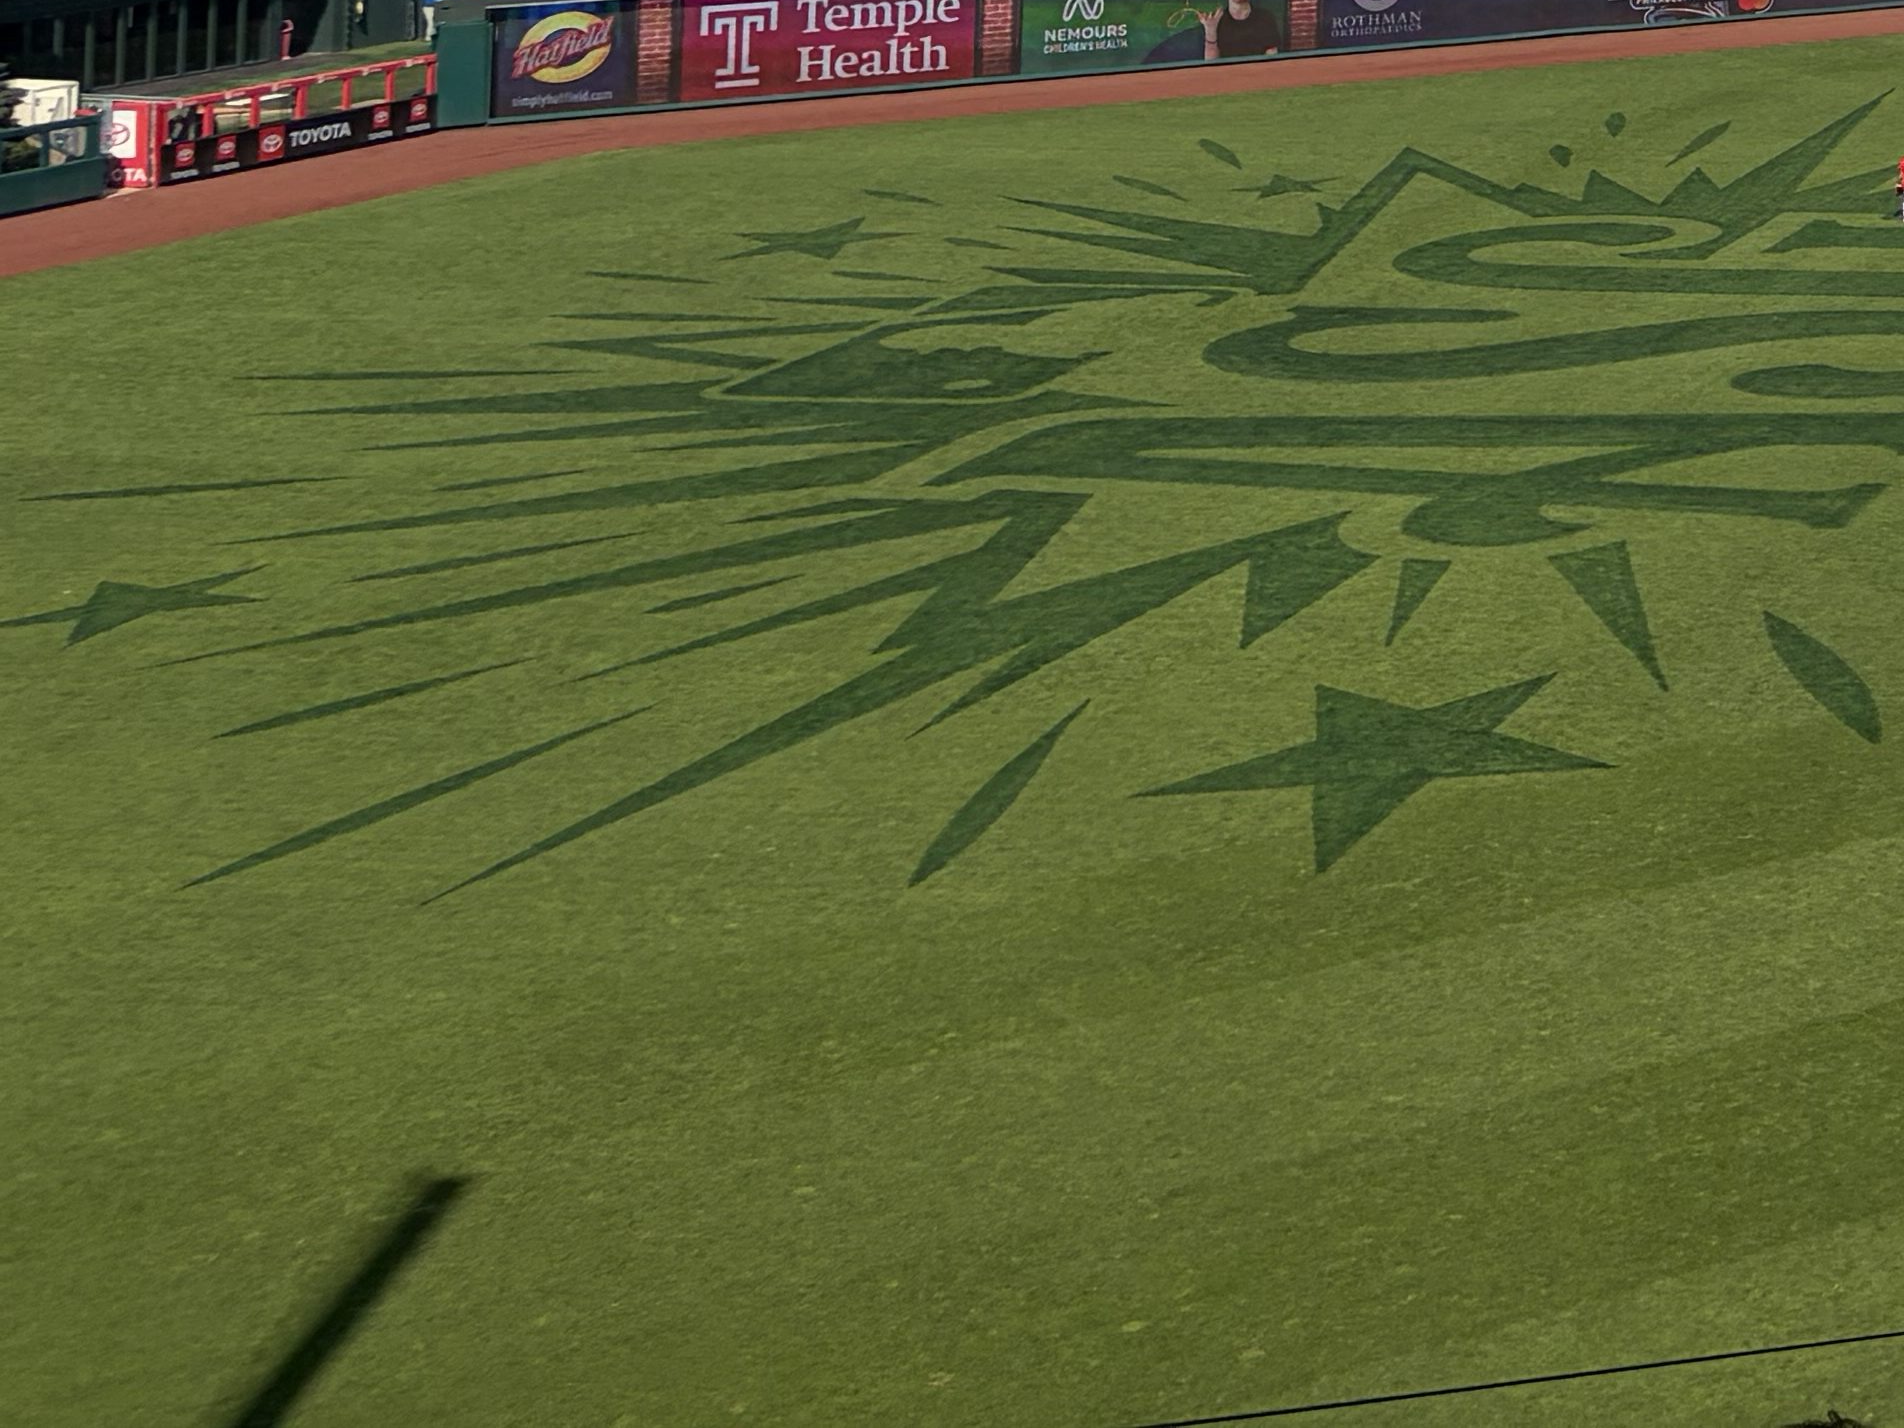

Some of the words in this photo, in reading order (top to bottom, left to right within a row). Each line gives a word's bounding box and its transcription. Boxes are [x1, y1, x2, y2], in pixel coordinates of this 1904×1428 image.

[1331, 10, 1423, 29] ROTHMAN
[1044, 24, 1128, 43] NEMOURS
[511, 15, 615, 79] Hatfield
[796, 36, 952, 83] Health
[289, 121, 352, 147] TOYOTA
